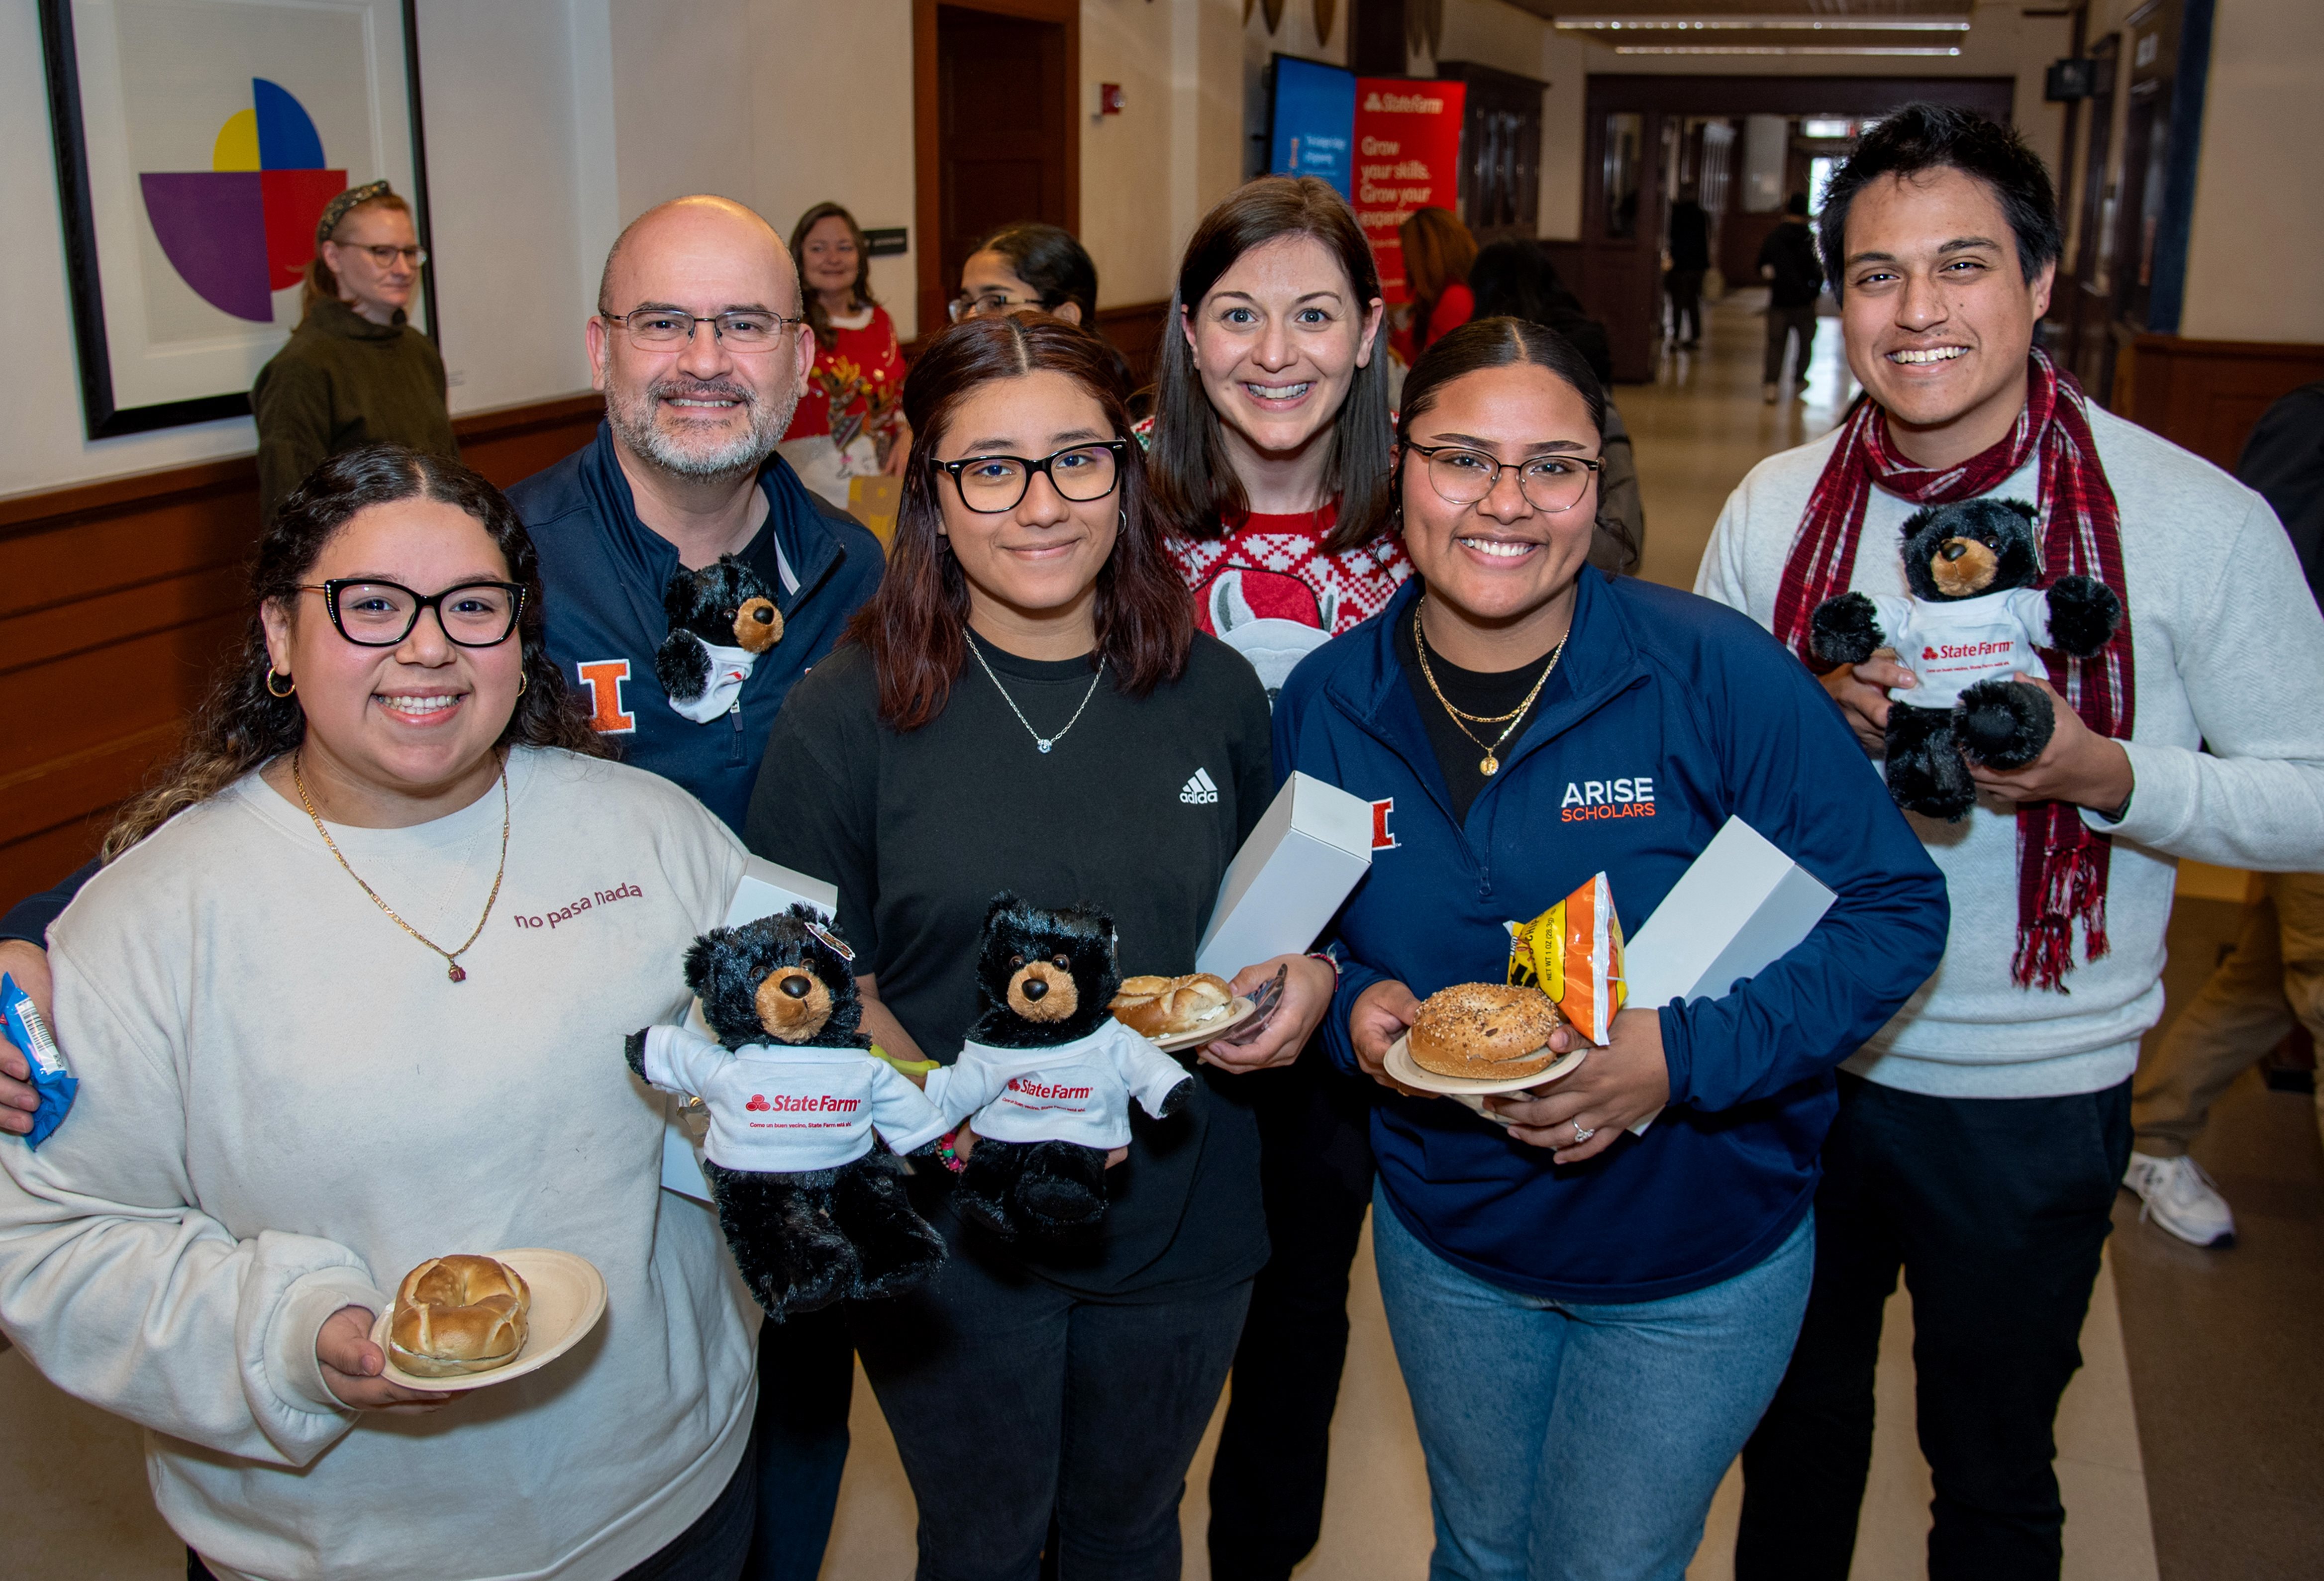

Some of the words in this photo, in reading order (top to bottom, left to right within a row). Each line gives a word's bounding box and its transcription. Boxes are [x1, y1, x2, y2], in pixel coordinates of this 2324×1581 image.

[1361, 135, 1400, 156] Grow
[1361, 165, 1393, 185] your
[1360, 183, 1398, 203] Grow
[1396, 187, 1432, 210] your
[1180, 791, 1218, 804] adida
[1561, 778, 1655, 807] ARISE
[1561, 802, 1655, 822] SCHOLARS
[514, 915, 543, 929] no
[546, 897, 592, 929] pasa
[595, 883, 643, 905] nada
[1545, 917, 1554, 939] (28.3g)
[1545, 940, 1552, 949] OZ
[1545, 957, 1551, 967] WT
